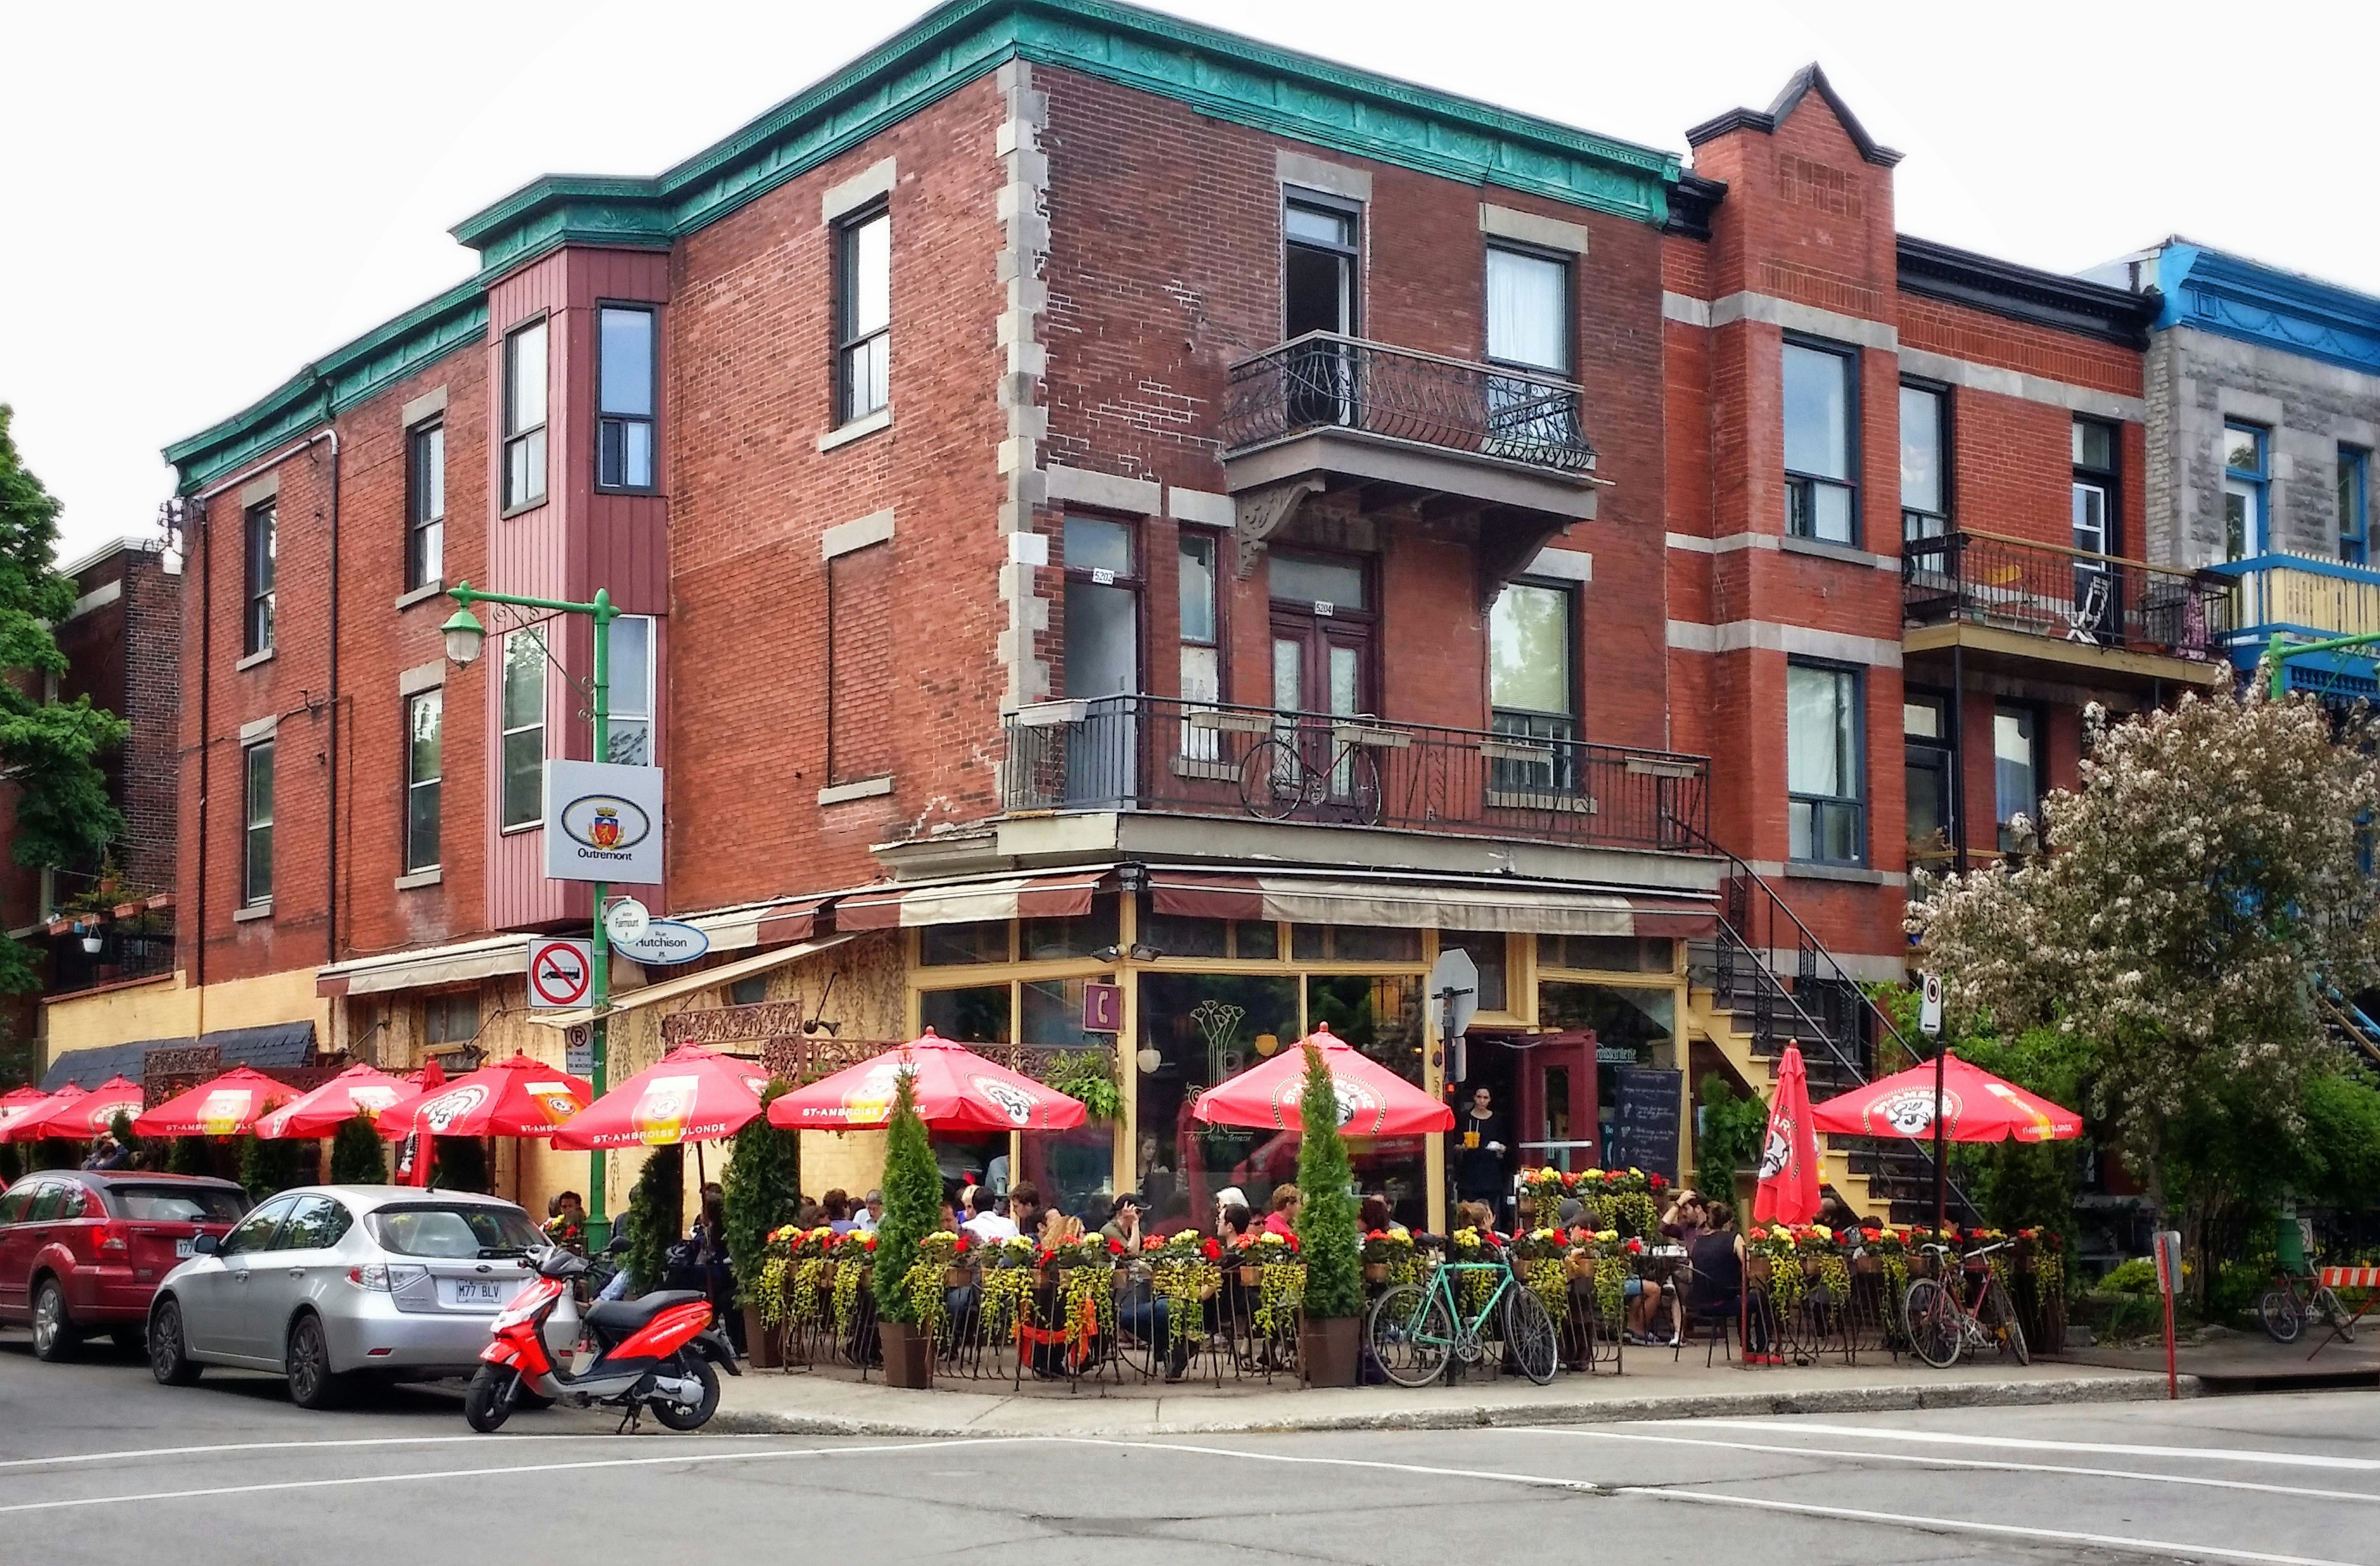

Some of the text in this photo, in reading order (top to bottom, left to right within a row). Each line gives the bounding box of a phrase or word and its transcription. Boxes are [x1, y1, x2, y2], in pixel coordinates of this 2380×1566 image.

[1095, 571, 1113, 582] 5202
[1317, 603, 1331, 613] 5204
[578, 848, 632, 861] Outremont
[636, 938, 688, 947] Hutchison
[802, 1105, 927, 1117] ST-AMBROISE BDE
[593, 1123, 726, 1143] ST-AMBROISE BLONDE
[482, 1286, 499, 1297] BLV
